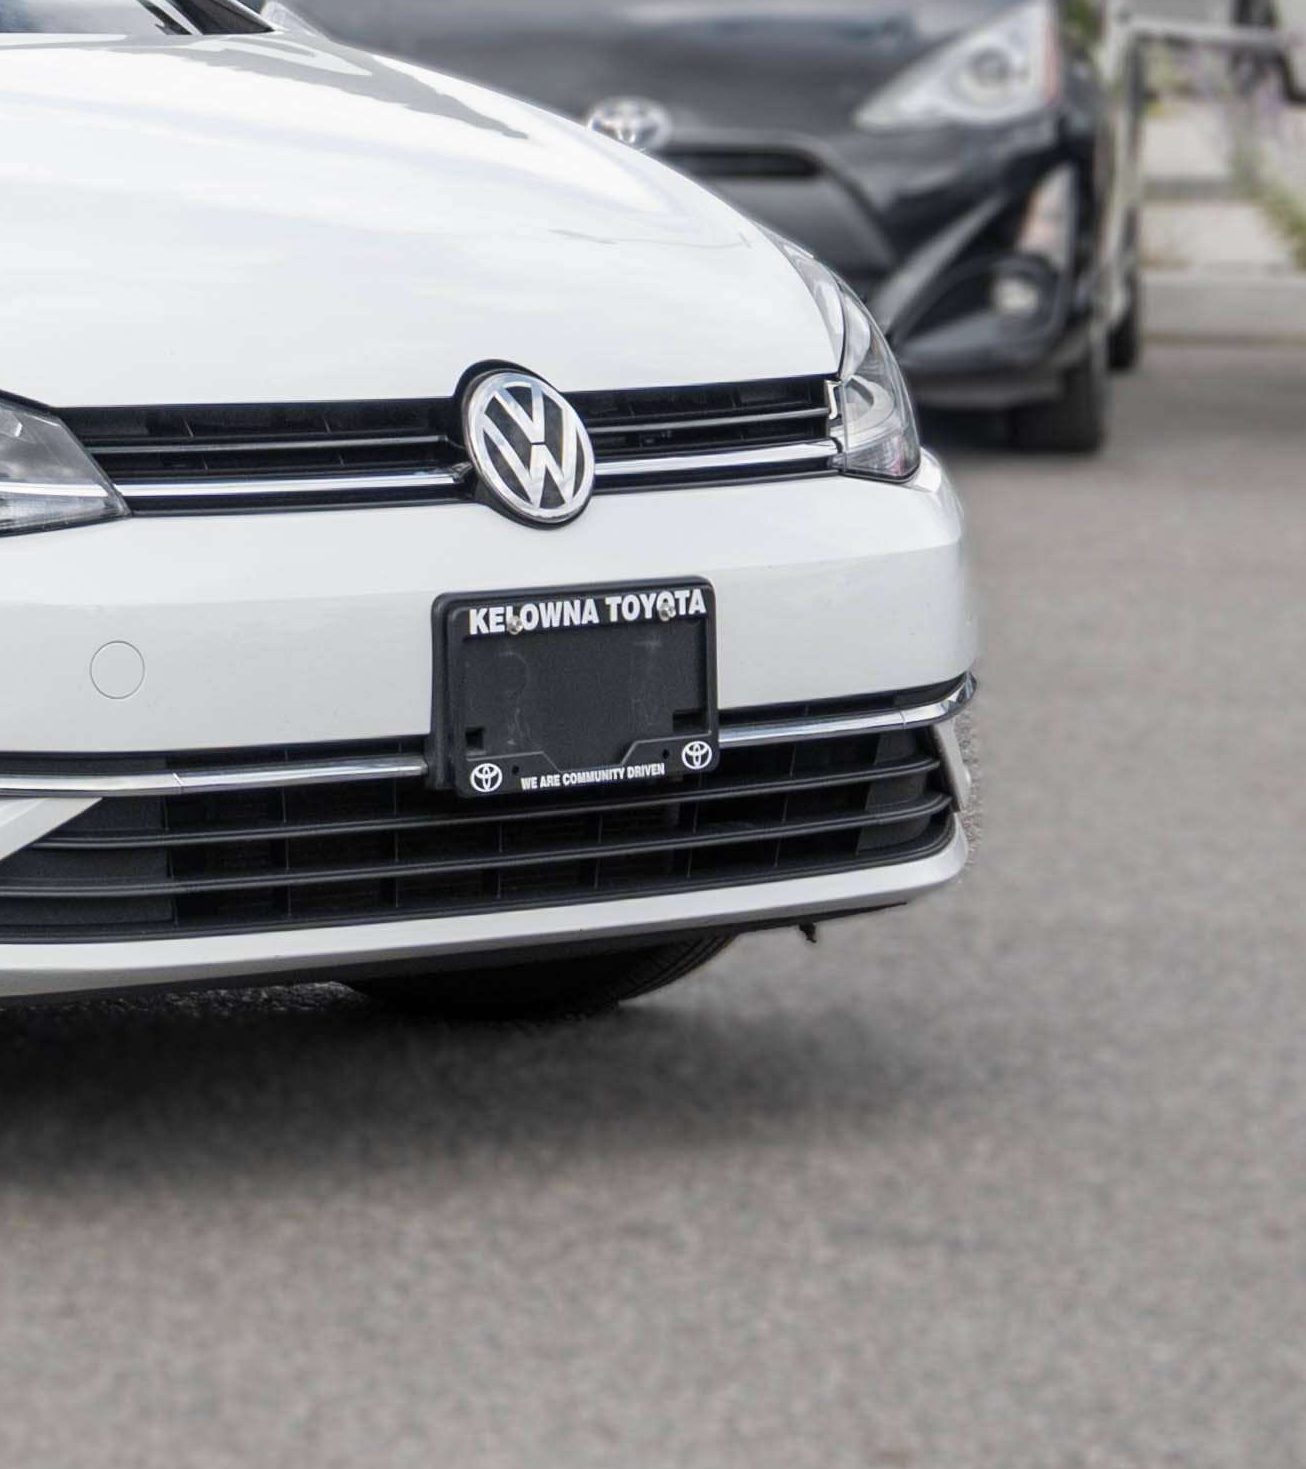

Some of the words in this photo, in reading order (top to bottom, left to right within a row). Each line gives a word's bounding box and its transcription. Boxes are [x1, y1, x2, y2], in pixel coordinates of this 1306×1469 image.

[469, 598, 599, 635] KELOWNA
[605, 589, 707, 623] TOYOTA
[521, 776, 538, 790] WE
[540, 774, 561, 788] ARE
[562, 767, 626, 786] COMMUNITY
[627, 762, 666, 779] DRIVEN
